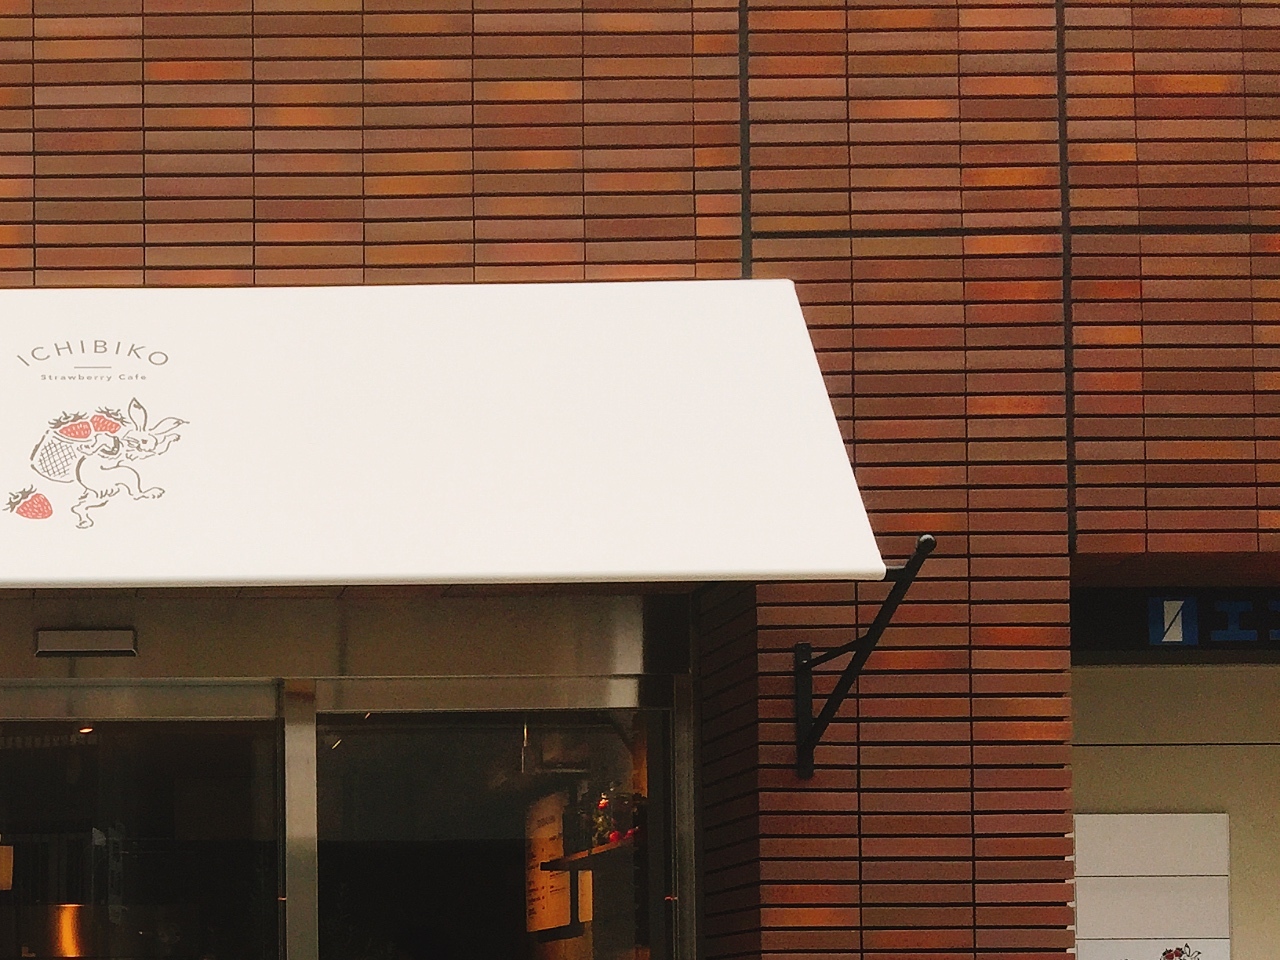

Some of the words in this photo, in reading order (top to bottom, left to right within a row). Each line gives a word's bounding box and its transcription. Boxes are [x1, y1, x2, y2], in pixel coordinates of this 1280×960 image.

[17, 339, 169, 367] ICHIBIKO
[40, 374, 112, 382] Strawberry
[119, 373, 147, 381] Cafe
